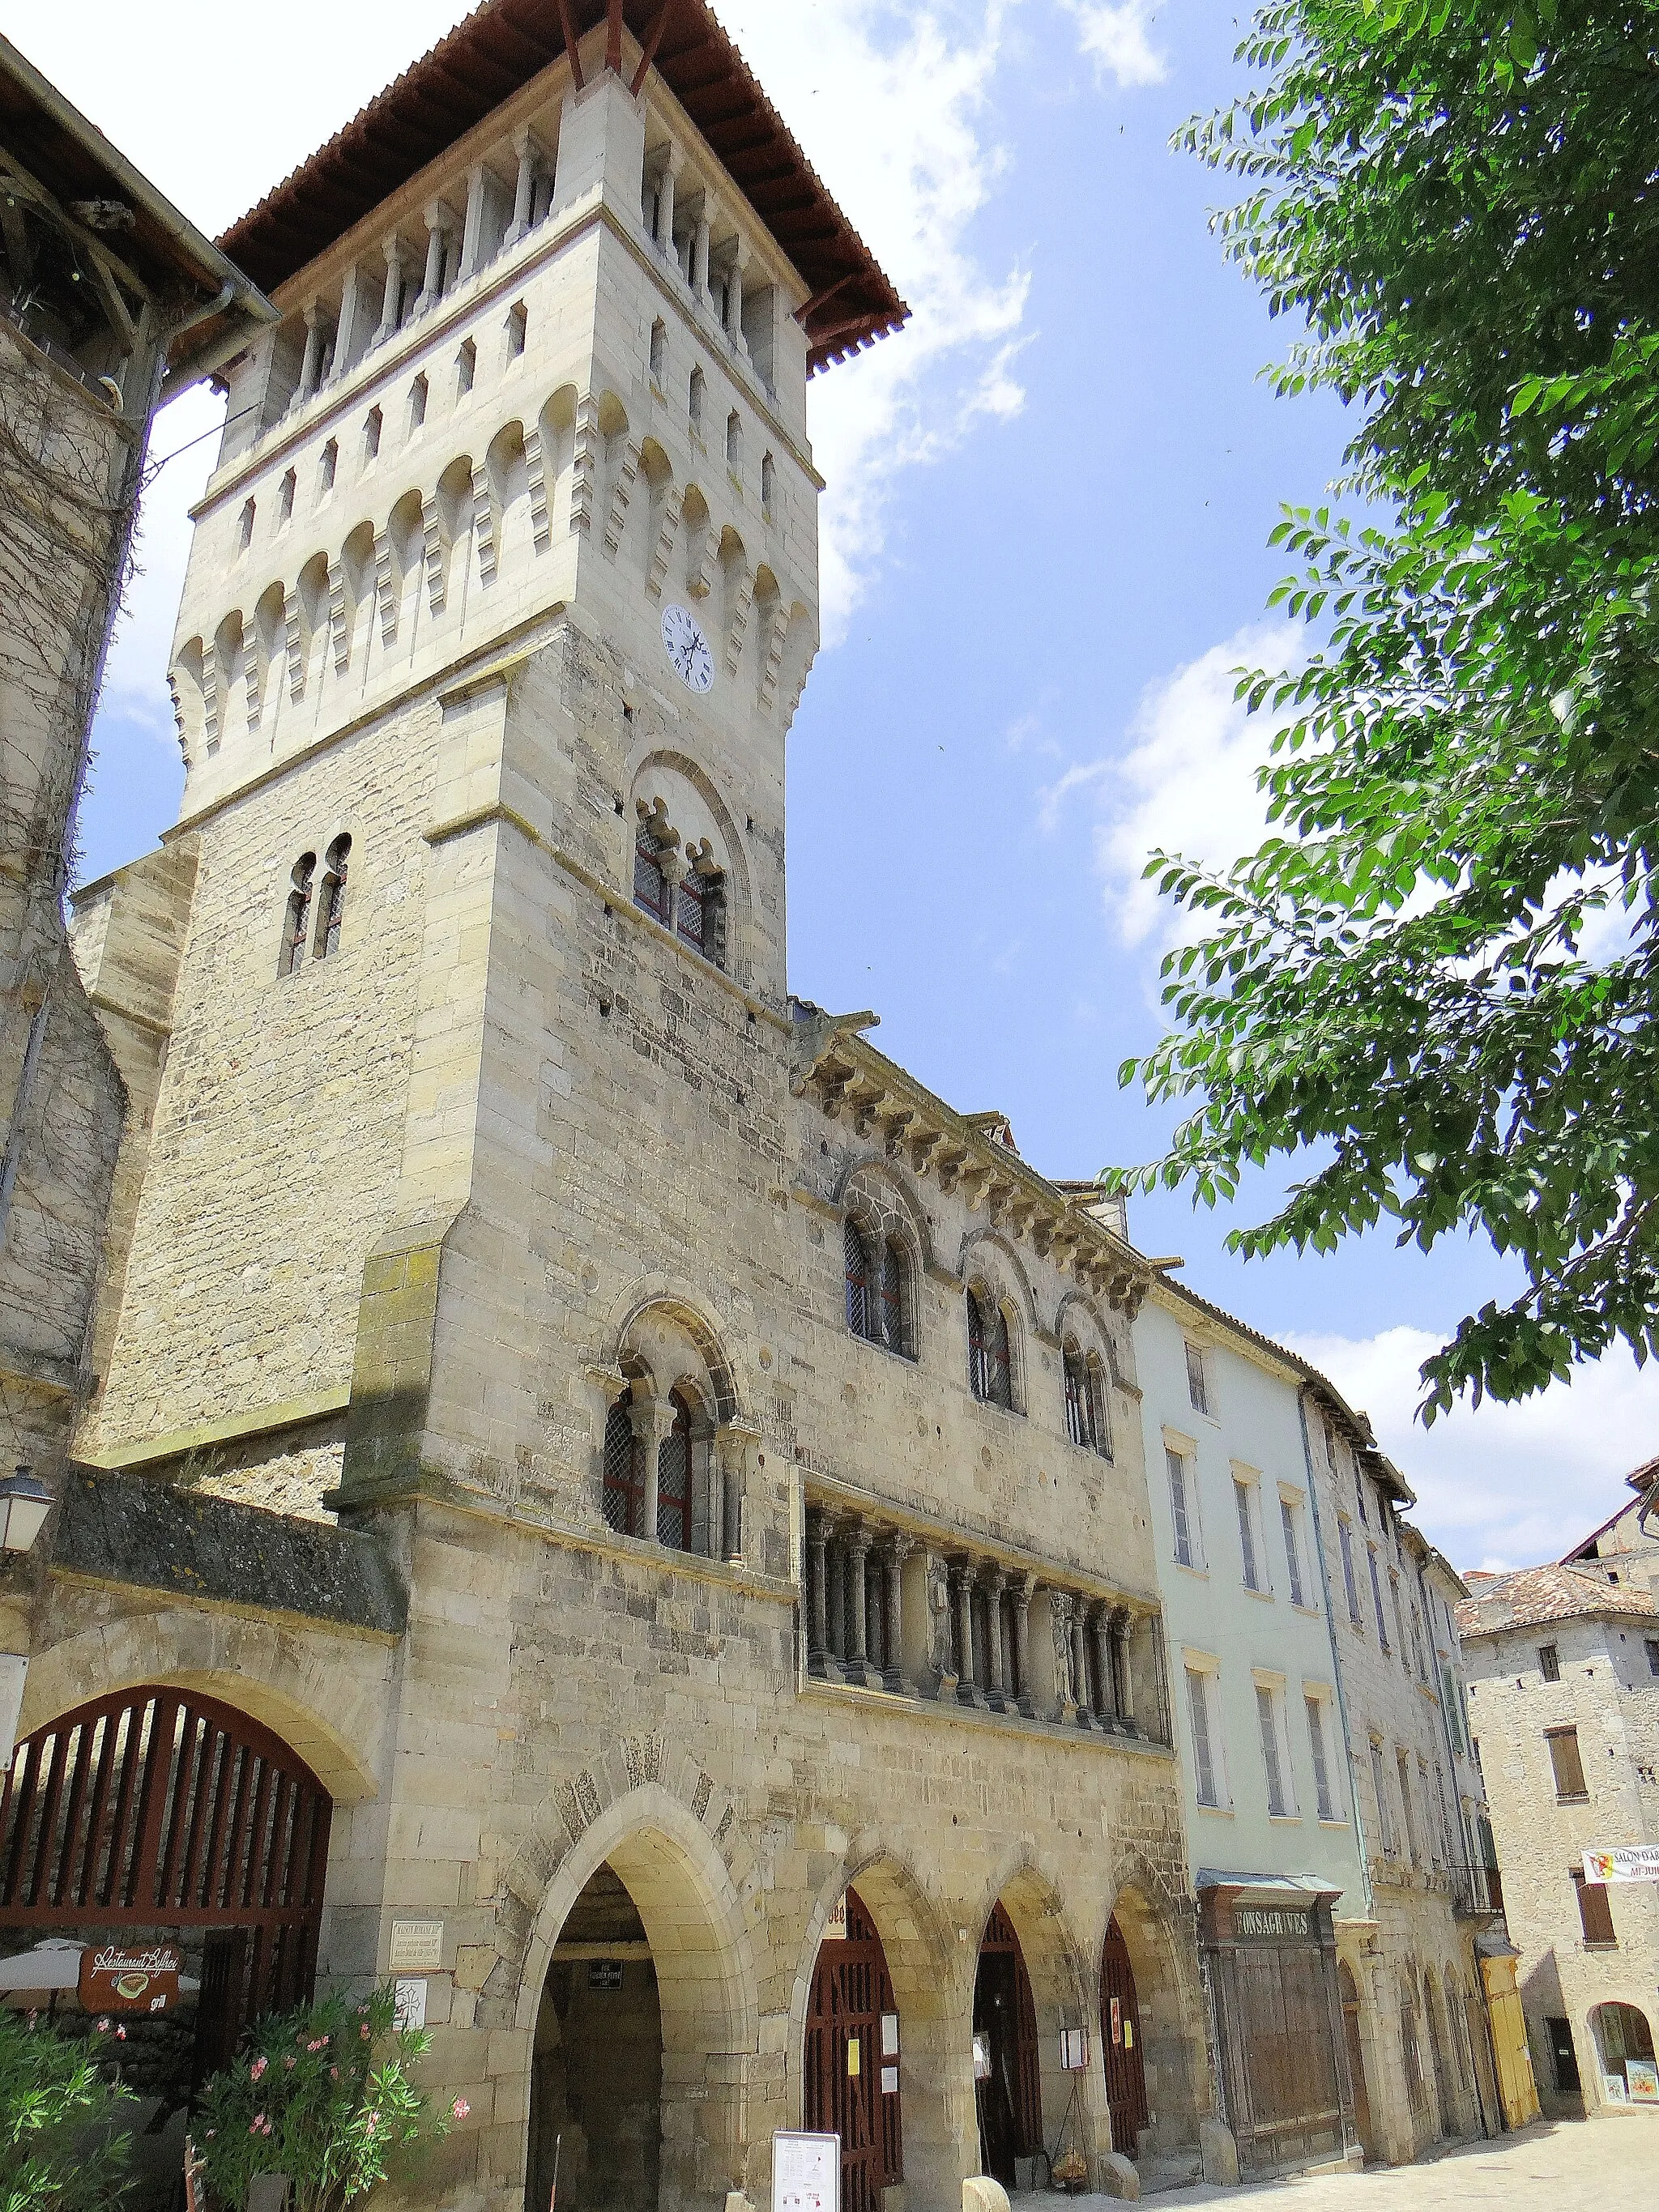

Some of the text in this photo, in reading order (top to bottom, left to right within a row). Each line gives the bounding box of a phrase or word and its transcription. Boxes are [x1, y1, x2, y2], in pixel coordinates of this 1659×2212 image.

[1614, 1851, 1640, 1863] SALON
[1235, 1912, 1308, 1935] FONSAGRIVES
[91, 1946, 178, 1977] Restaurant Beffroi
[150, 1993, 167, 2011] grill
